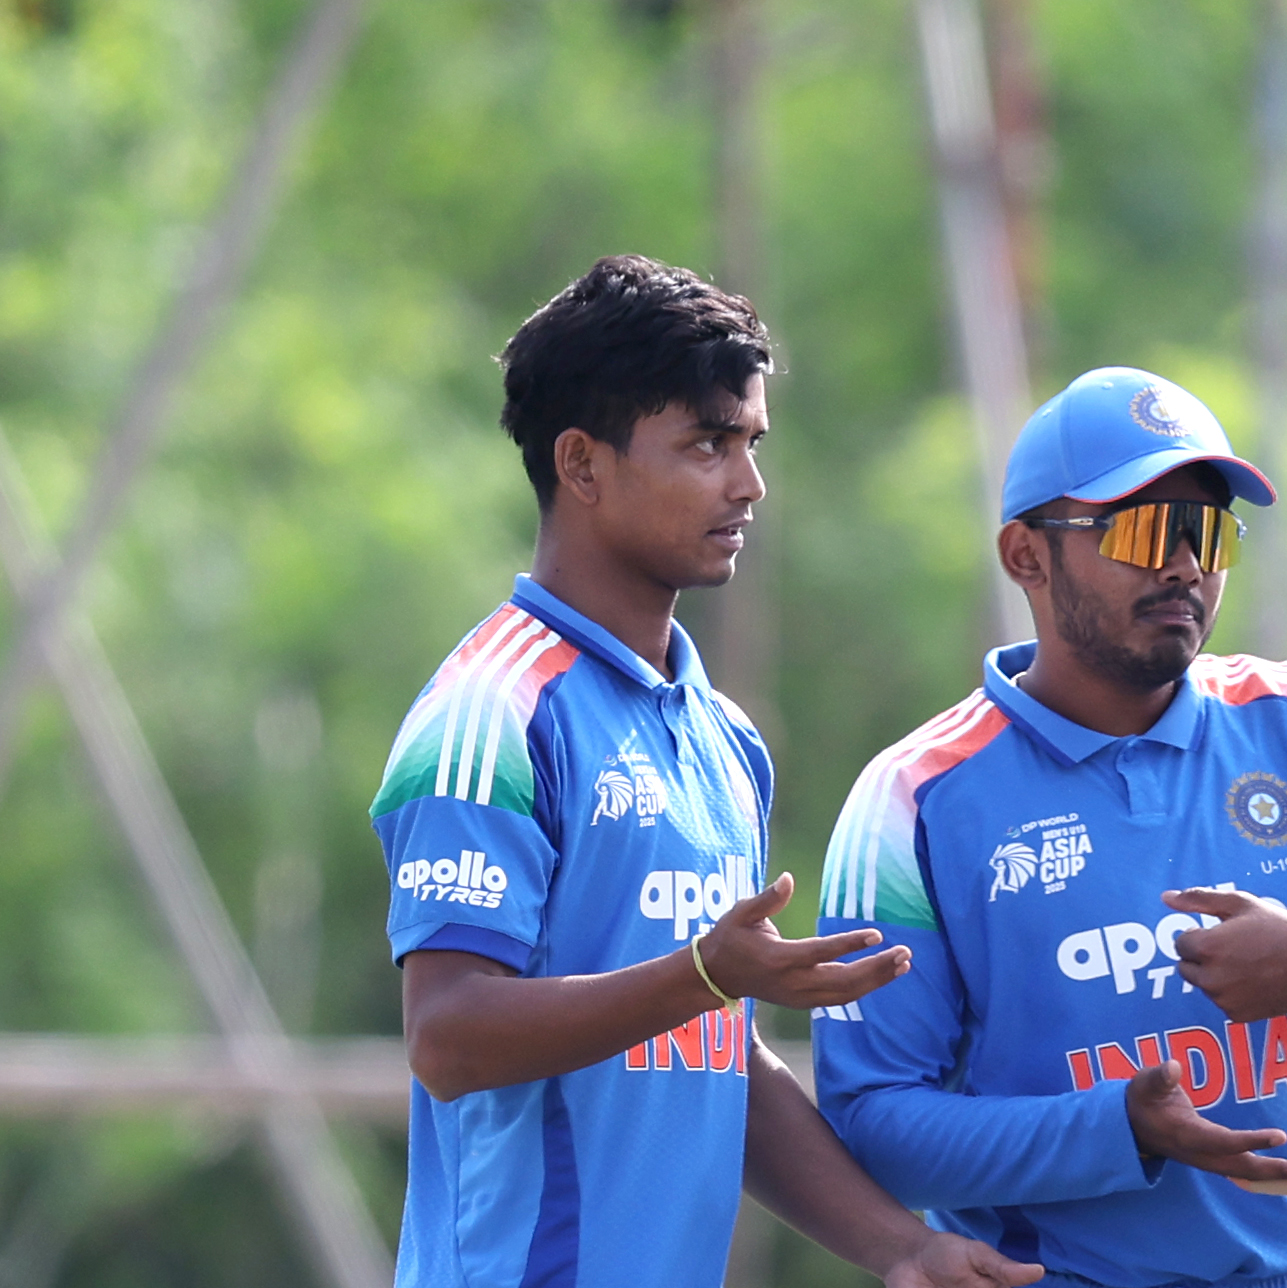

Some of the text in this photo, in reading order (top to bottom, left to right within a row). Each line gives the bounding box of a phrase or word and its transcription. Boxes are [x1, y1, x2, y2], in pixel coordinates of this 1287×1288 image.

[1021, 812, 1079, 833] DP WORLD
[1040, 833, 1093, 863] ASIA
[397, 849, 508, 897] apollo
[1040, 855, 1086, 884] CUP
[420, 884, 504, 909] TYRES
[640, 855, 756, 940] apoll
